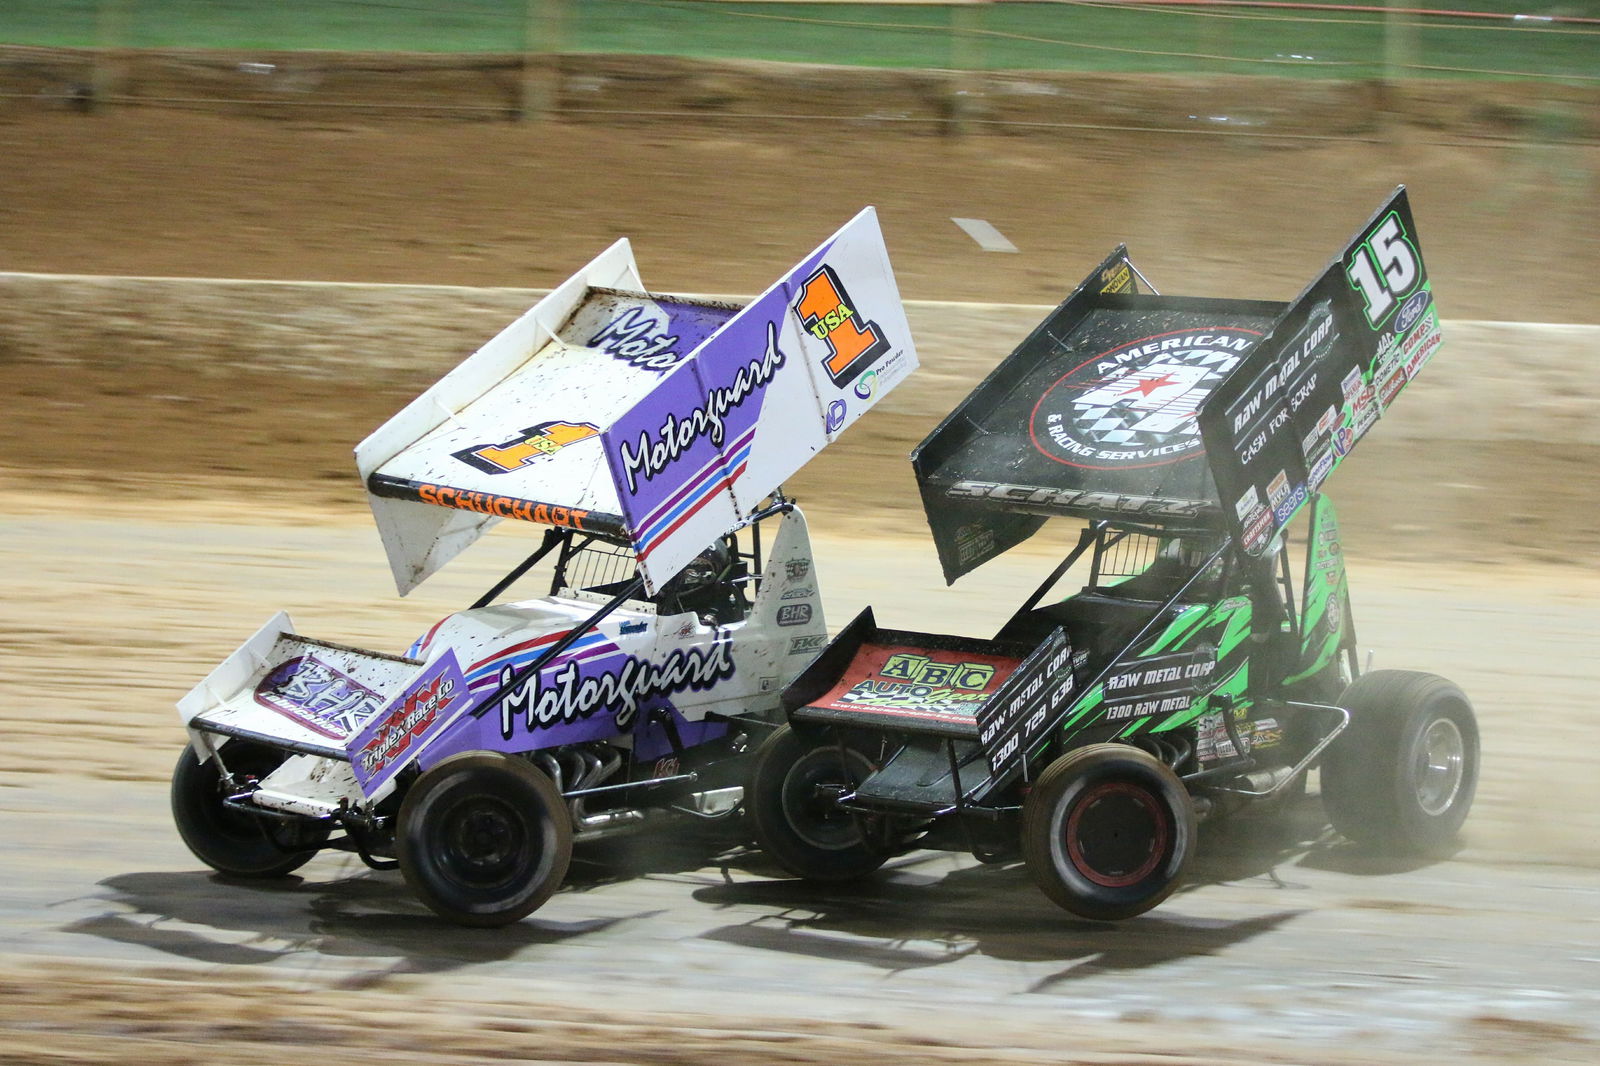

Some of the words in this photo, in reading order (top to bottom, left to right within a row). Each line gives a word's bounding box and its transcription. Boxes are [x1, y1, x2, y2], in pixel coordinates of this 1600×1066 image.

[1349, 215, 1416, 324] 15
[793, 263, 892, 390] 1
[810, 303, 853, 340] USA
[1400, 297, 1424, 328] Ford
[1096, 334, 1254, 375] AMERICAN
[1234, 391, 1262, 435] RAW
[1303, 314, 1333, 358] CORP
[1406, 333, 1441, 378] AMERICAN
[620, 320, 787, 496] Motorguard
[1047, 413, 1062, 425] &
[1241, 430, 1267, 465] CASH
[1269, 407, 1291, 435] FOR
[1291, 373, 1317, 412] SCRAP
[450, 420, 600, 475] 1
[1049, 425, 1097, 457] RACING
[1096, 438, 1200, 460] SERVICES
[418, 484, 589, 529] SCHUCHART
[1277, 487, 1305, 522] sears
[500, 630, 736, 740] Motorguard
[851, 679, 934, 697] AUTO
[926, 688, 990, 705] Gear
[884, 658, 988, 690] ABC
[1108, 671, 1143, 690] RAW
[1143, 665, 1182, 686] METAL
[1184, 660, 1216, 678] CORP
[406, 694, 438, 730] Race
[438, 678, 456, 701] Co
[981, 709, 1008, 746] RAW
[1009, 673, 1044, 718] METAL
[991, 732, 1019, 772] 1300
[1025, 704, 1047, 738] 729
[1051, 674, 1074, 709] 638
[1106, 706, 1132, 720] 1300
[1133, 701, 1161, 717] RAW
[1160, 696, 1191, 711] METAL
